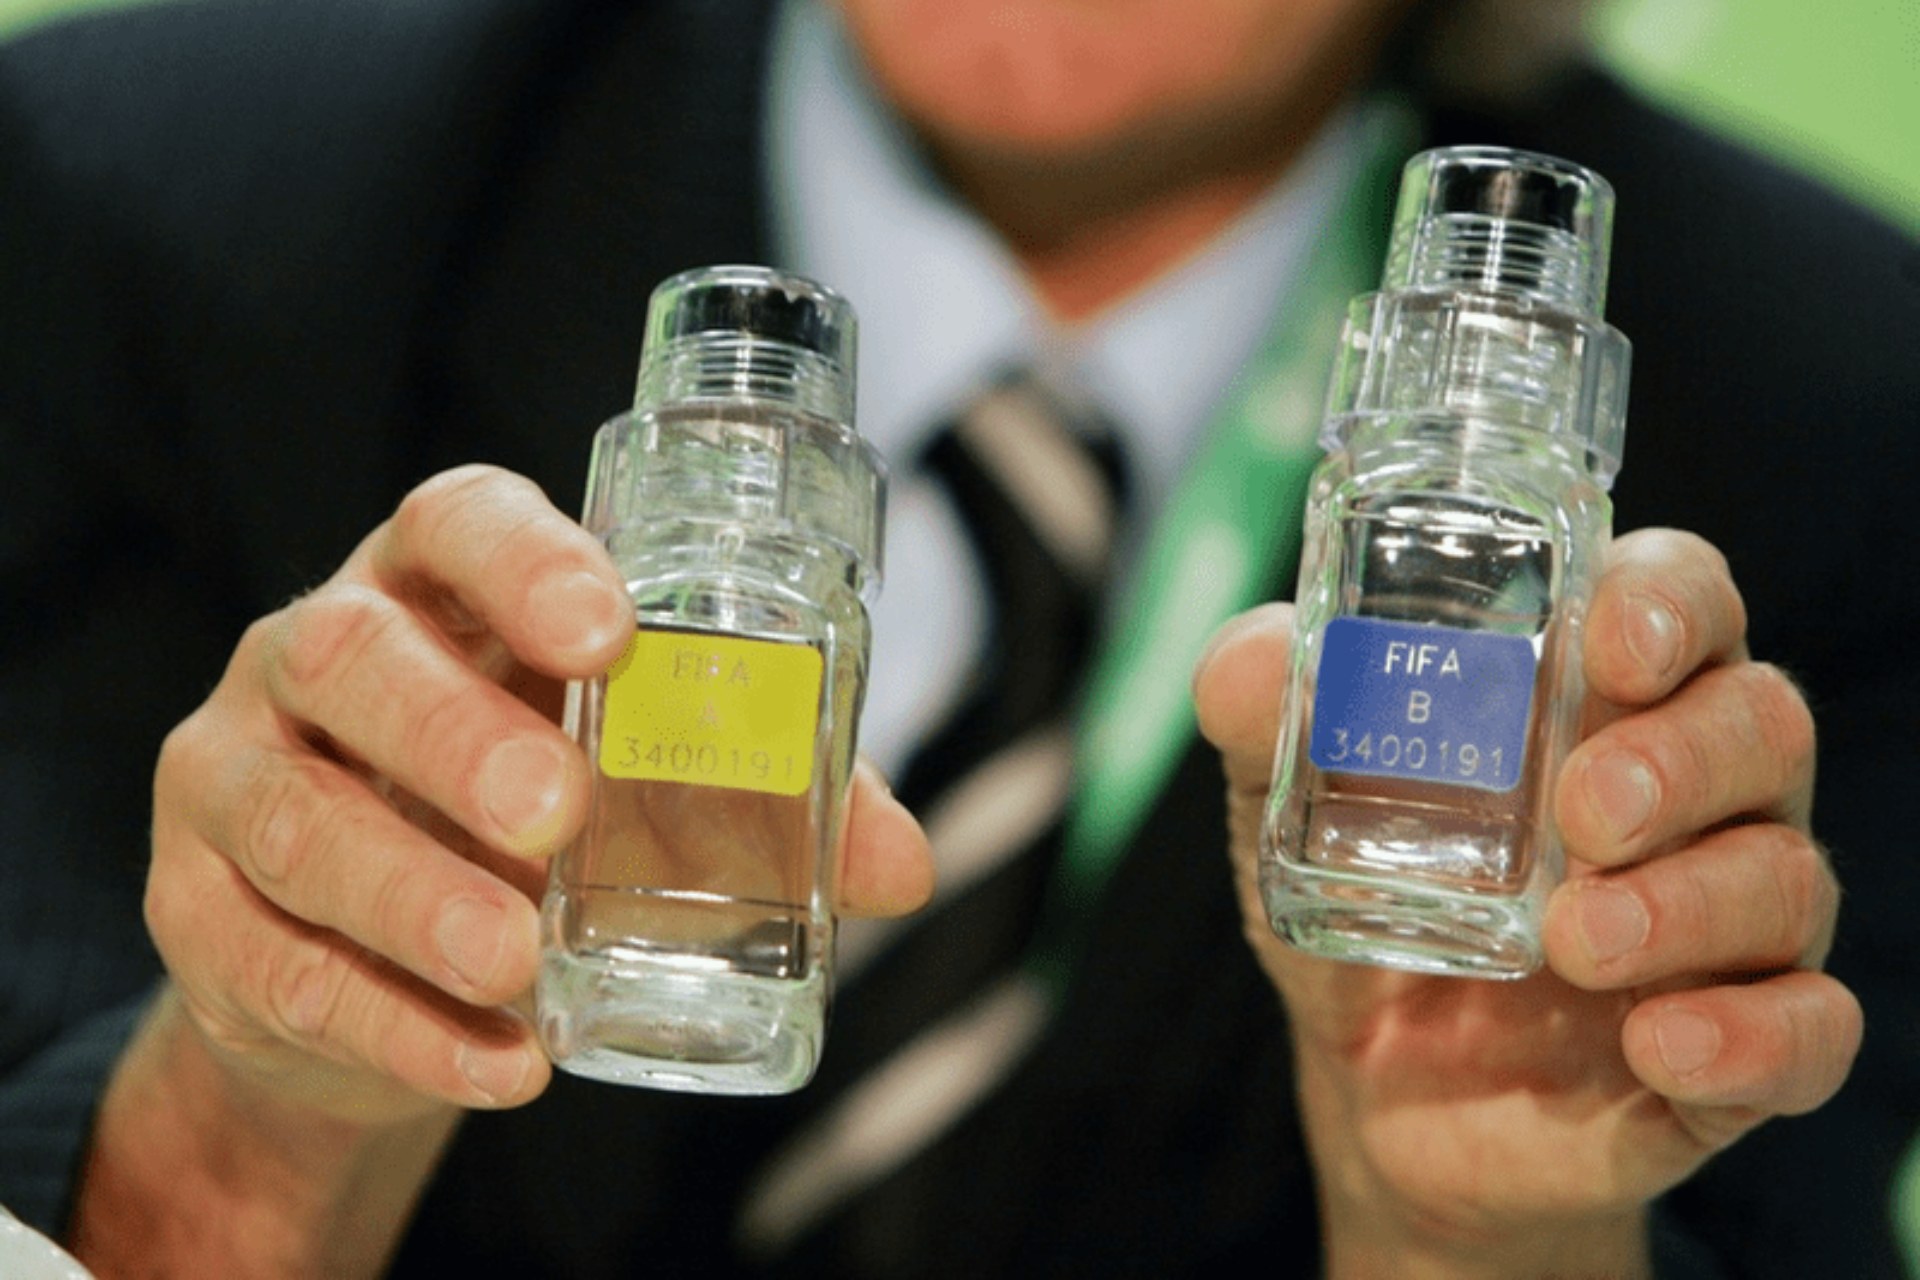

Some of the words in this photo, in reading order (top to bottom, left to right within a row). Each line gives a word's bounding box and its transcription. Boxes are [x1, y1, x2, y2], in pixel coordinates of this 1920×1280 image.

[673, 649, 750, 687] FIFA
[1383, 641, 1461, 680] FIFA
[699, 697, 720, 730] A
[1407, 690, 1432, 723] B
[618, 736, 794, 780] 3400191
[1325, 727, 1503, 776] 3400191
